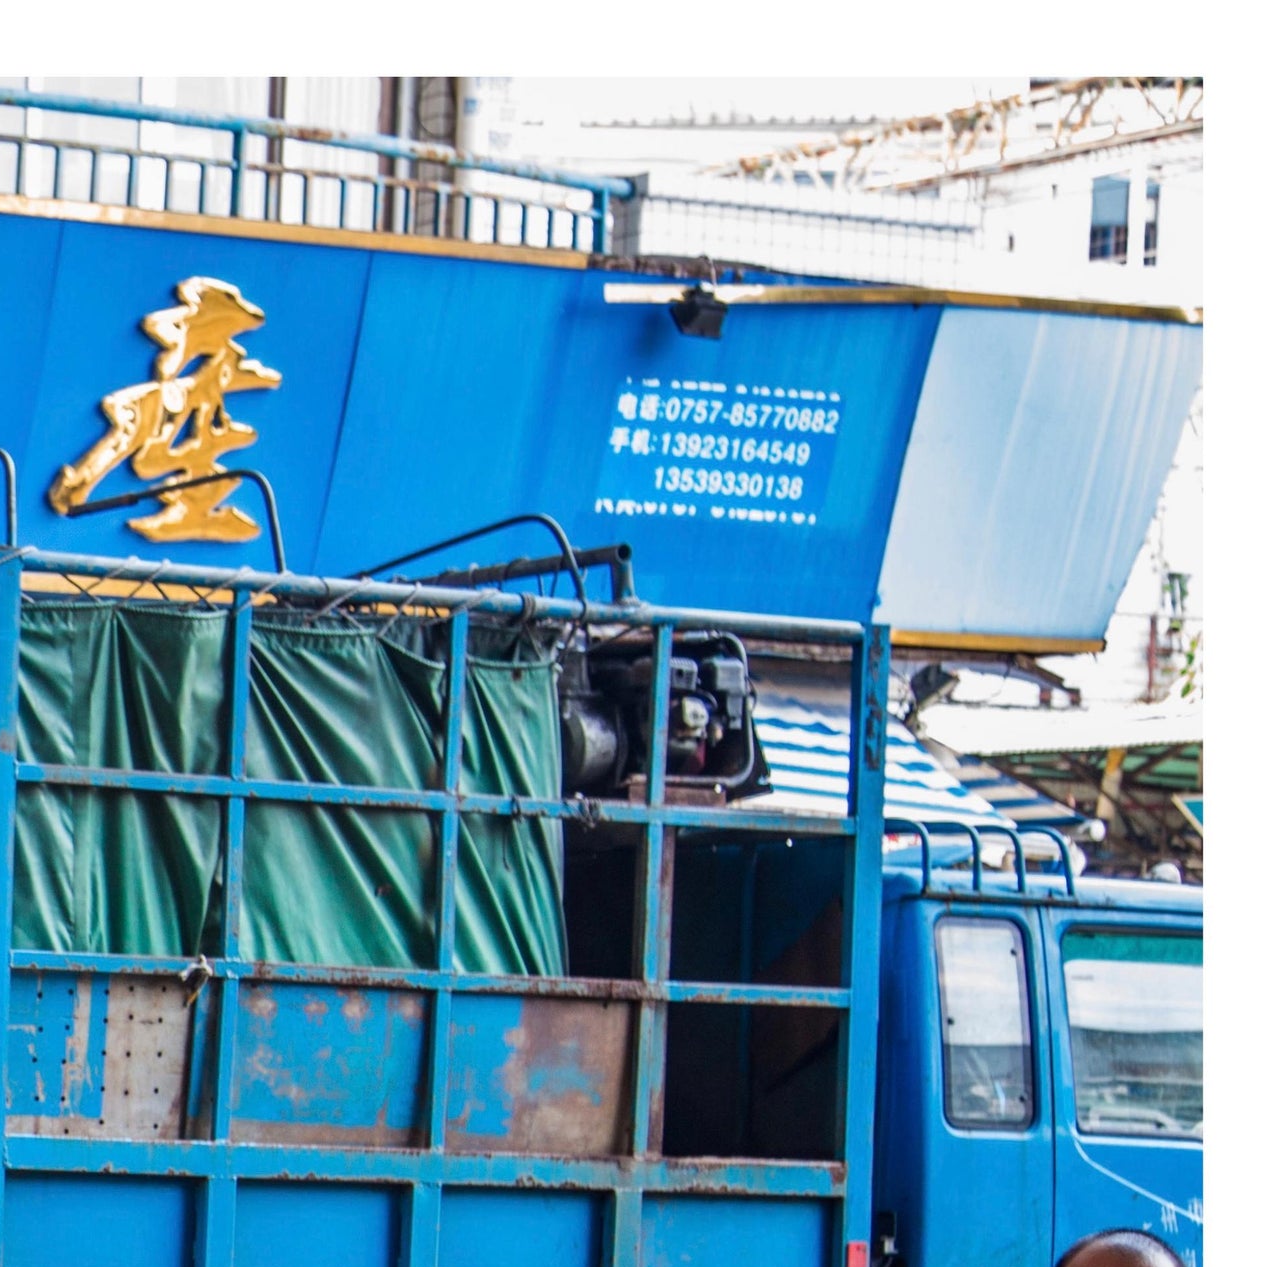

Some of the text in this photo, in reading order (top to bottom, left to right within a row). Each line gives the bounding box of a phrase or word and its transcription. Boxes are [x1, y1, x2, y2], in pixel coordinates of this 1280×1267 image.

[617, 391, 839, 433] 电话:0757-85770882
[609, 426, 810, 466] 手机:13923164549
[654, 466, 803, 500] 13539330138
